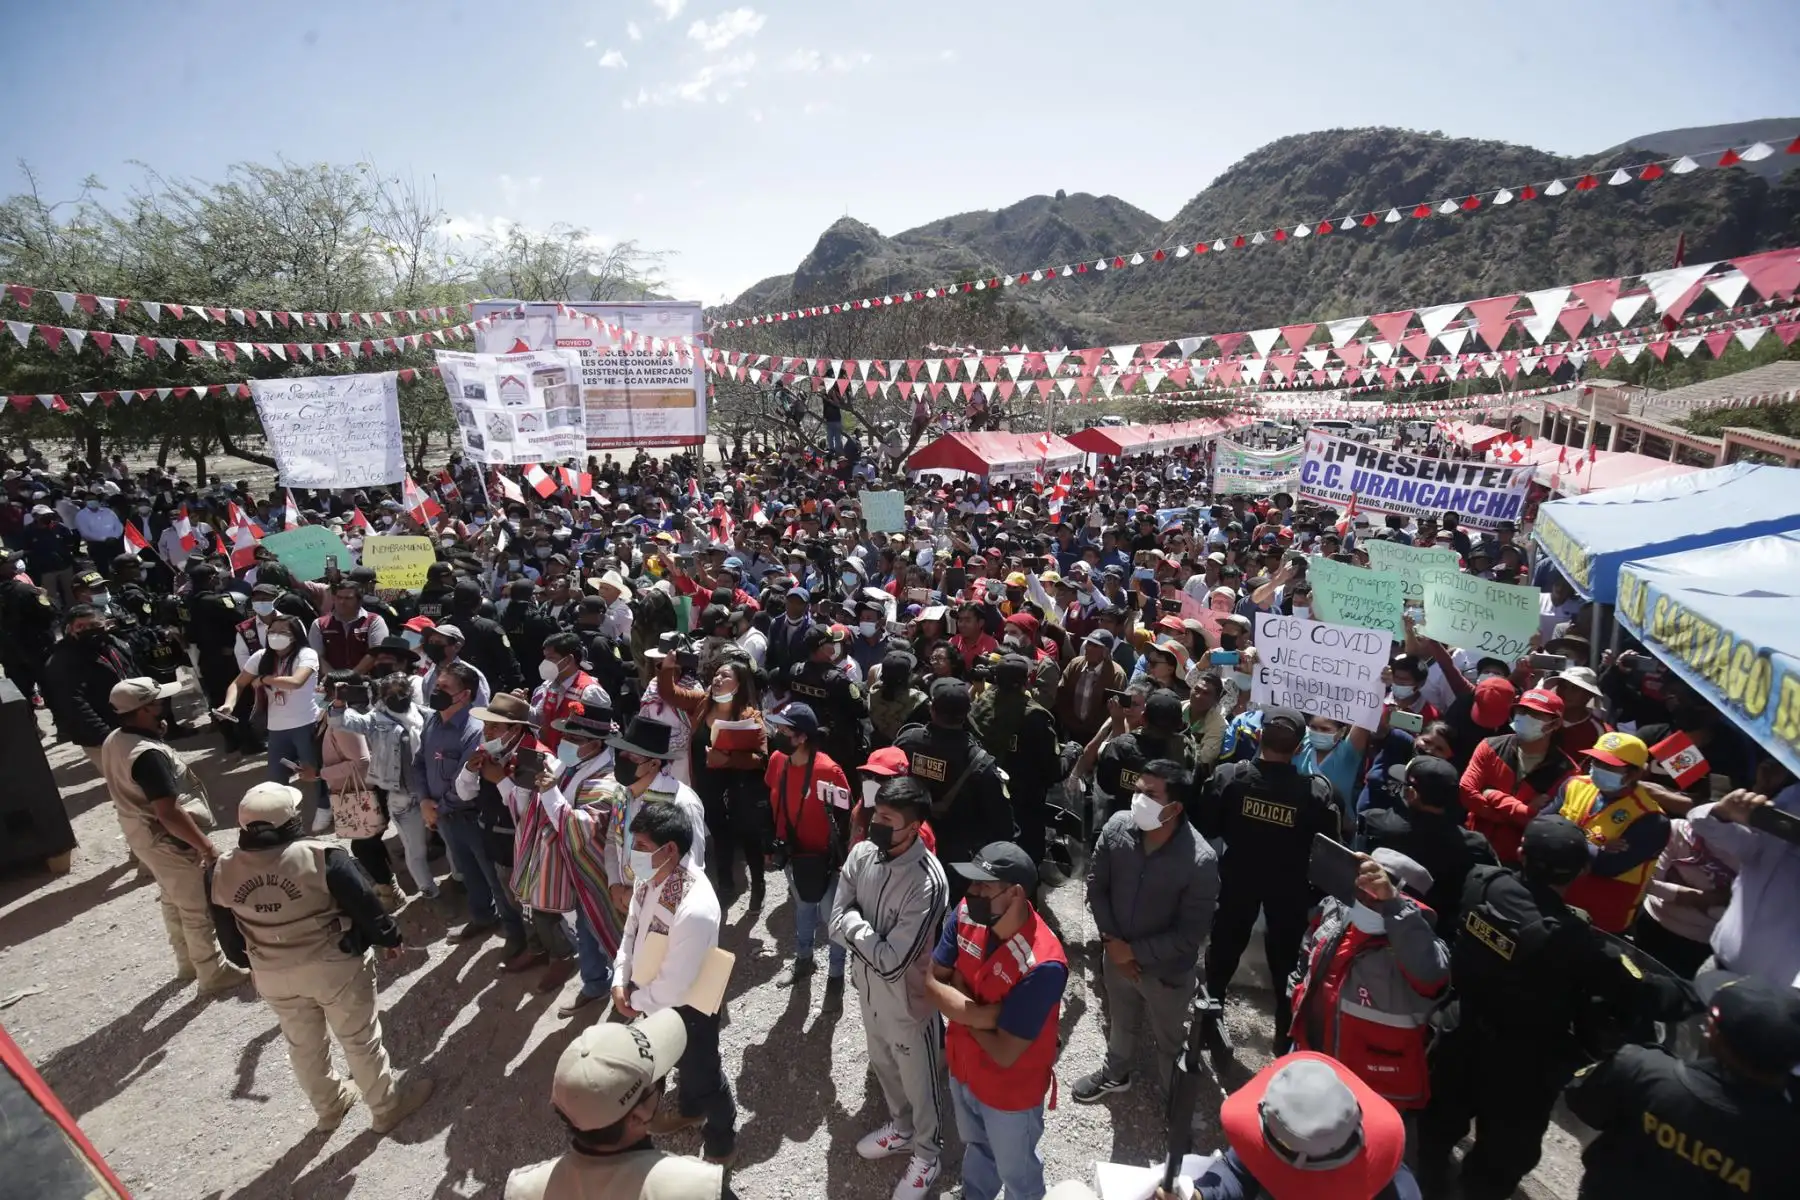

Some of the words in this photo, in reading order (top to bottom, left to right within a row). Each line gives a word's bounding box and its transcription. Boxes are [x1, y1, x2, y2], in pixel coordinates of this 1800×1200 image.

[582, 368, 634, 376] BSISTENCIA
[1324, 441, 1514, 489] ¡PRESENTE!
[1302, 460, 1344, 490] C.C.
[1350, 469, 1522, 520] URANCANCHA
[1317, 489, 1328, 498] DE
[1383, 501, 1430, 518] PROVINCIA
[1432, 590, 1496, 621] NUESTRA
[1262, 618, 1301, 641] CAS
[1311, 624, 1383, 655] COVID
[1450, 616, 1480, 635] LEY
[1270, 647, 1371, 681] NECESITA
[1260, 667, 1380, 709] ESTABILIDAD
[1271, 690, 1355, 722] LABORAL
[927, 759, 944, 773] USE
[1121, 771, 1139, 786] U.S
[1244, 800, 1293, 824] POLICIA
[266, 873, 279, 886] DEL
[254, 903, 282, 913] PNP
[1643, 1110, 1752, 1193] POLICIA
